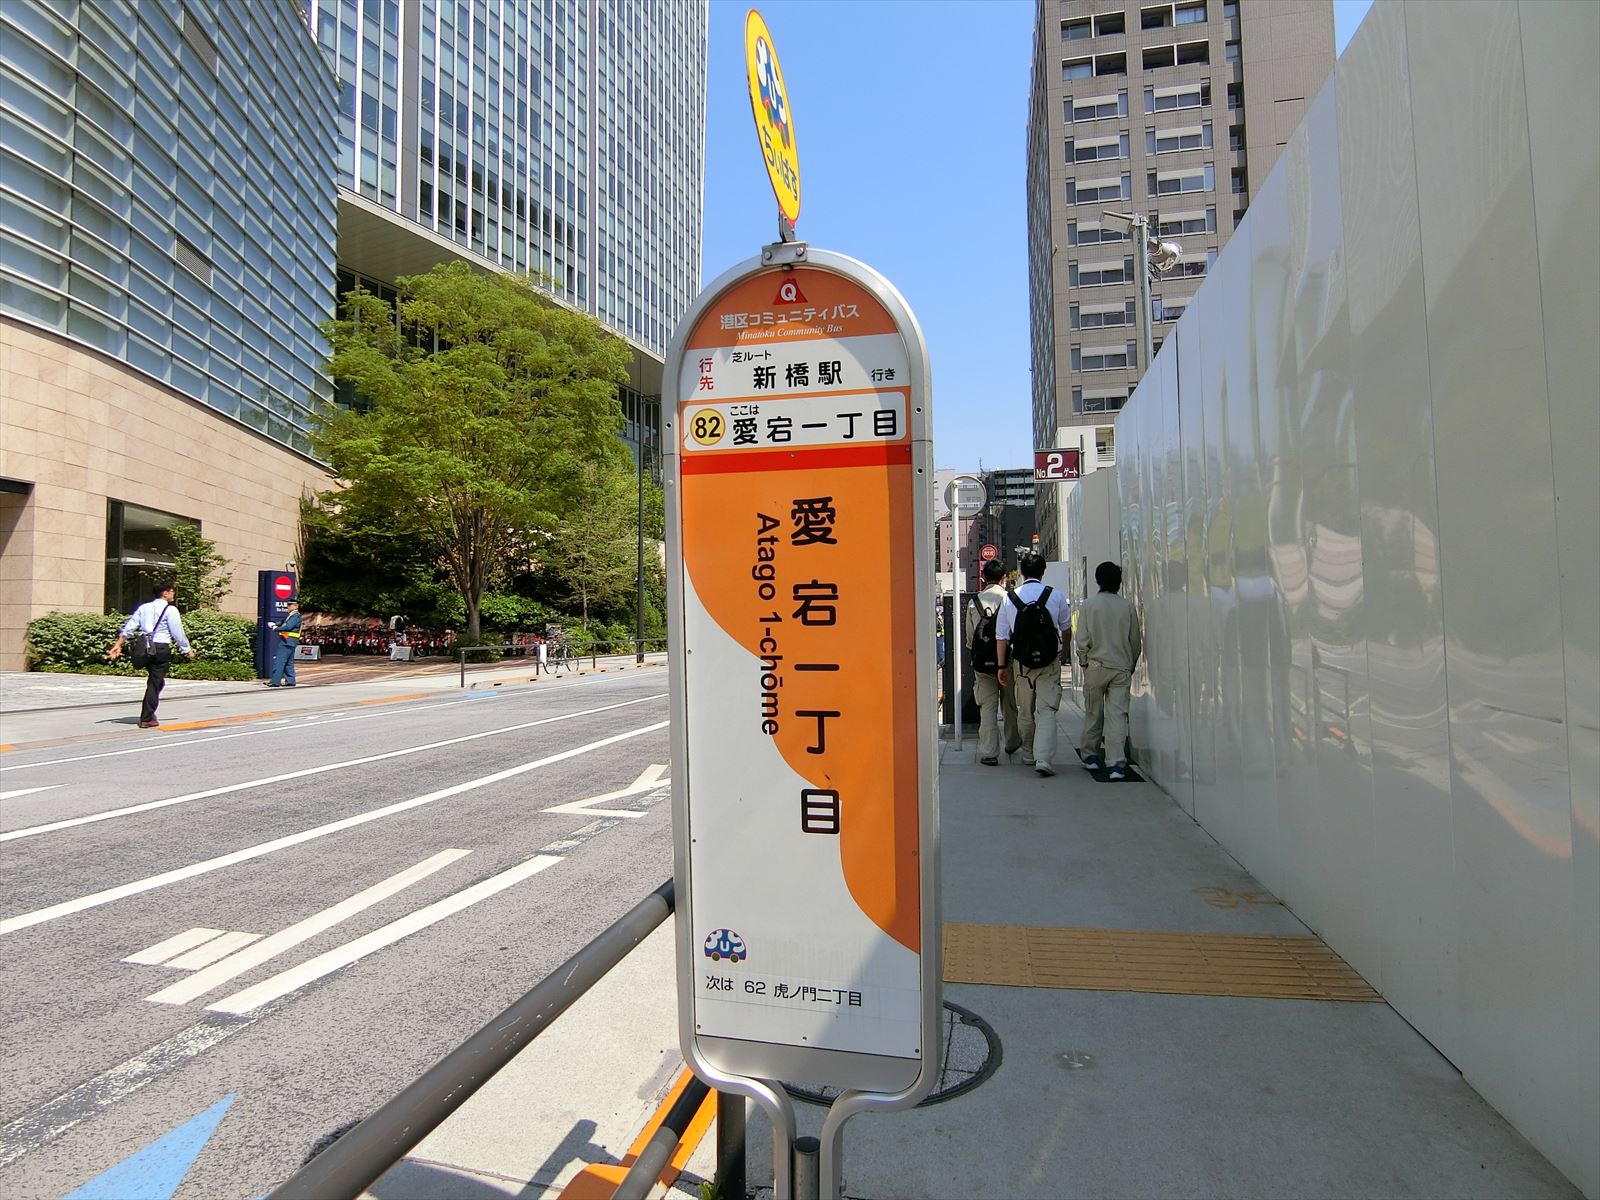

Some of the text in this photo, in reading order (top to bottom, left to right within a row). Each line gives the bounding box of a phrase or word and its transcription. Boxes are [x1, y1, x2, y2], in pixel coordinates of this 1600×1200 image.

[780, 283, 797, 301] Q
[720, 304, 860, 330] 港区コミュニティバス
[736, 323, 843, 340] Minatoku Community Bus
[732, 350, 772, 363] 芝ルート
[699, 357, 714, 390] 行先
[753, 360, 896, 390] 新橋駅 行き
[730, 404, 760, 416] ここは
[695, 409, 897, 445] 82 愛宕一丁目
[752, 512, 780, 600] Atago
[790, 496, 842, 834] 愛宕一丁目
[705, 975, 862, 1007] 次は 62 虎ノ門二丁目
